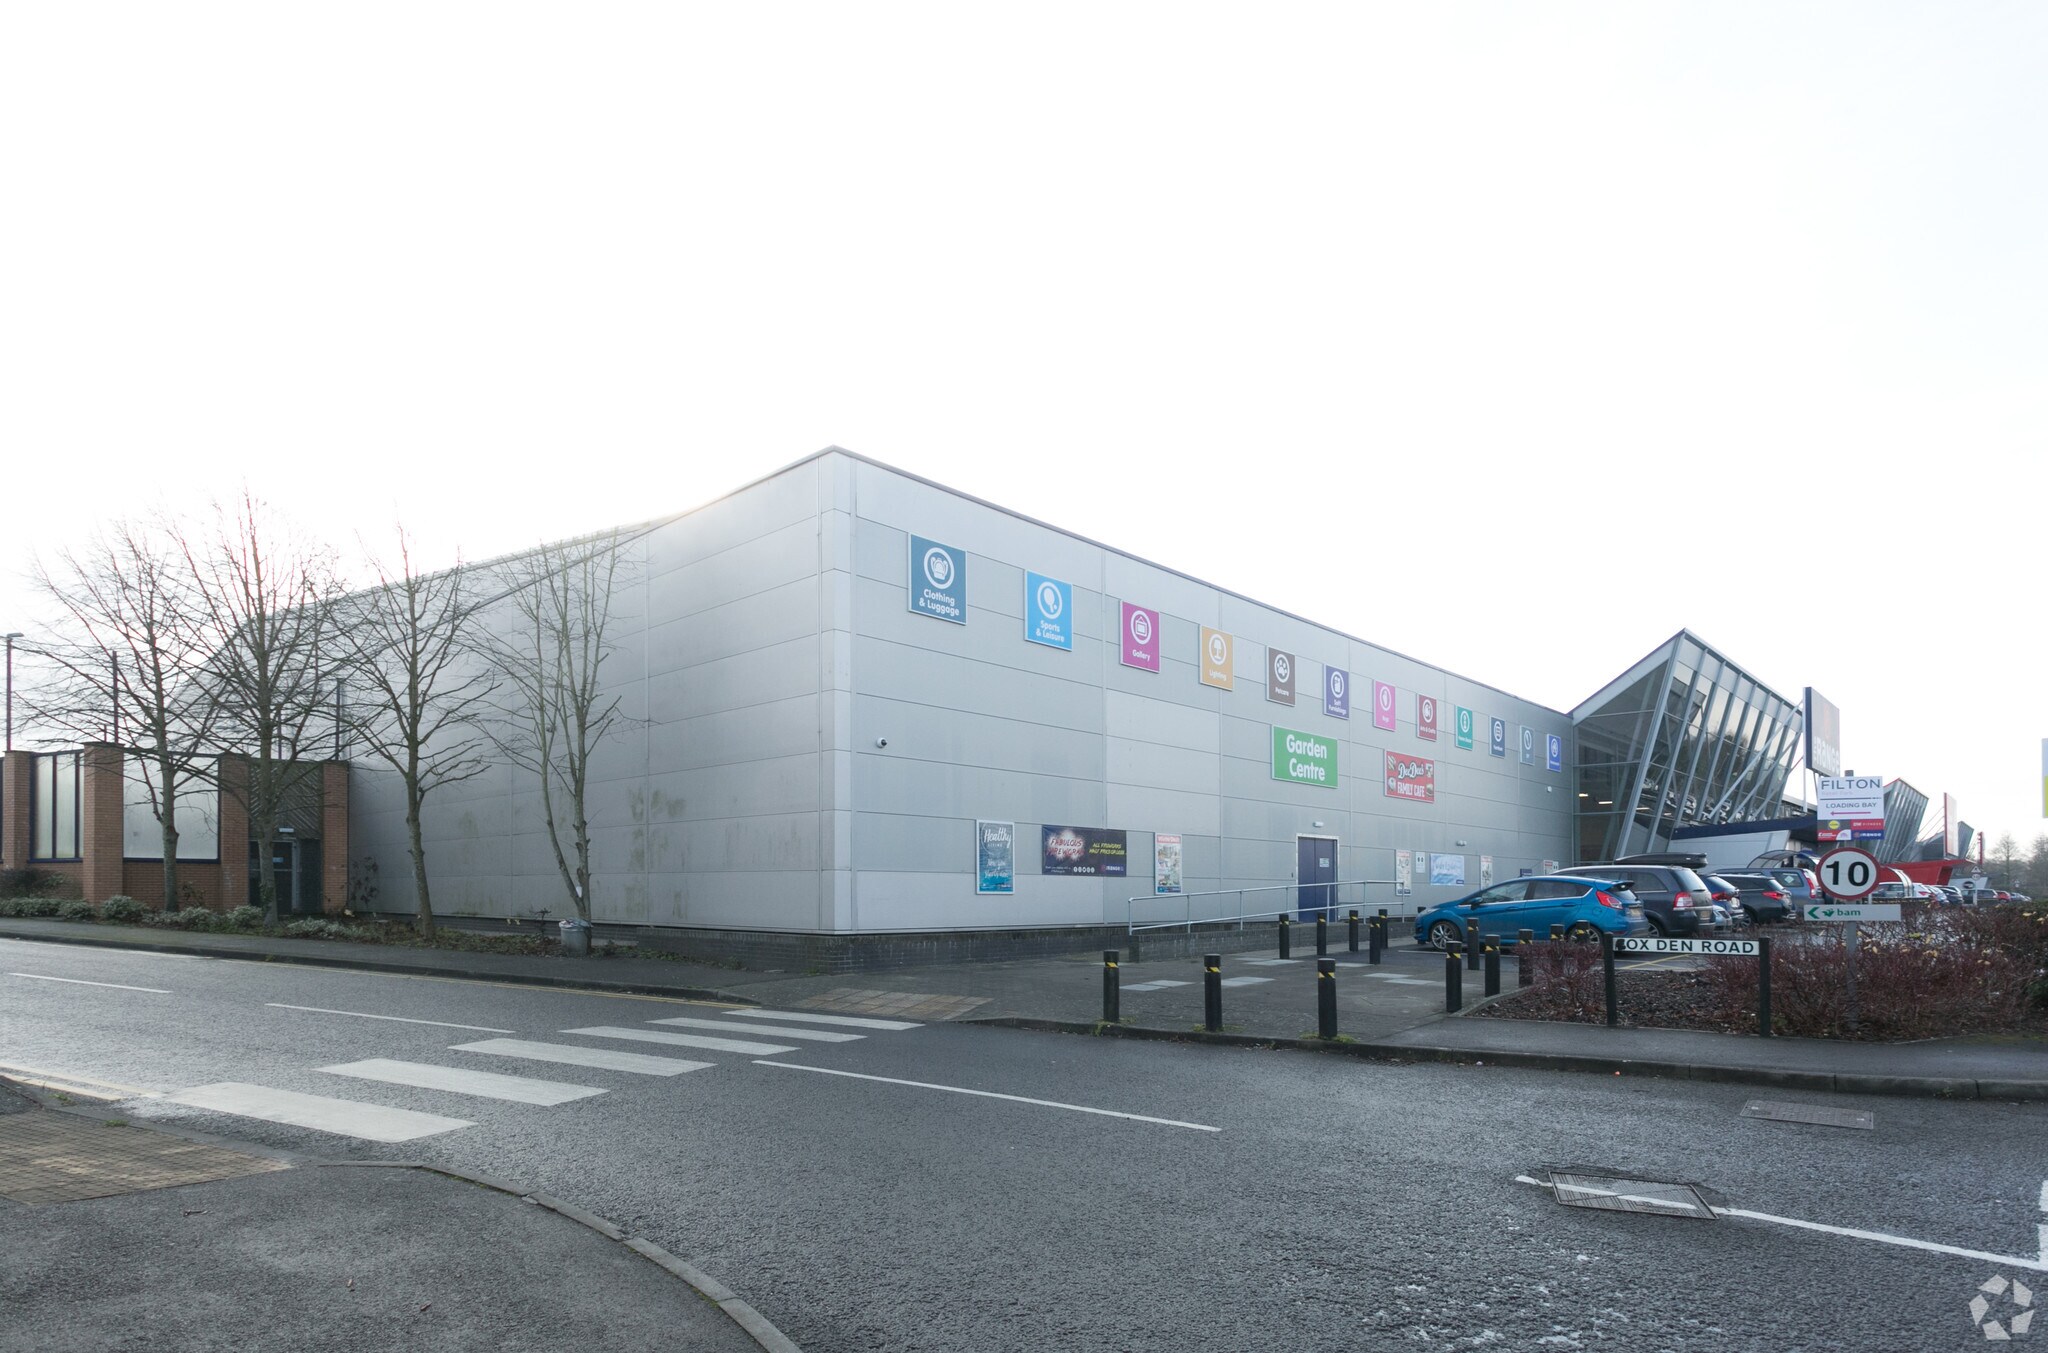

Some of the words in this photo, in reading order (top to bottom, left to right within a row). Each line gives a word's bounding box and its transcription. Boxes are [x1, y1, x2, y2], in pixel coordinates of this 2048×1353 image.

[923, 588, 955, 607] Clothing
[918, 597, 926, 607] &
[927, 600, 960, 617] Luggage
[1040, 619, 1060, 633] Sports
[1035, 627, 1041, 637] &
[1042, 629, 1065, 643] Leisure
[1132, 649, 1150, 662] Gallery
[1209, 669, 1227, 682] Lighting
[1286, 734, 1327, 759] Garden
[1289, 757, 1325, 781] Centre
[1397, 781, 1413, 796] FAMILY
[1821, 779, 1880, 790] FILTON
[984, 827, 1011, 848] Healthy
[1050, 838, 1082, 847] FABULOUS
[1826, 861, 1869, 887] 10
[1837, 908, 1861, 916] bam
[1615, 938, 1650, 950] OX
[1656, 939, 1693, 951] DEN
[1701, 941, 1754, 954] ROAD
